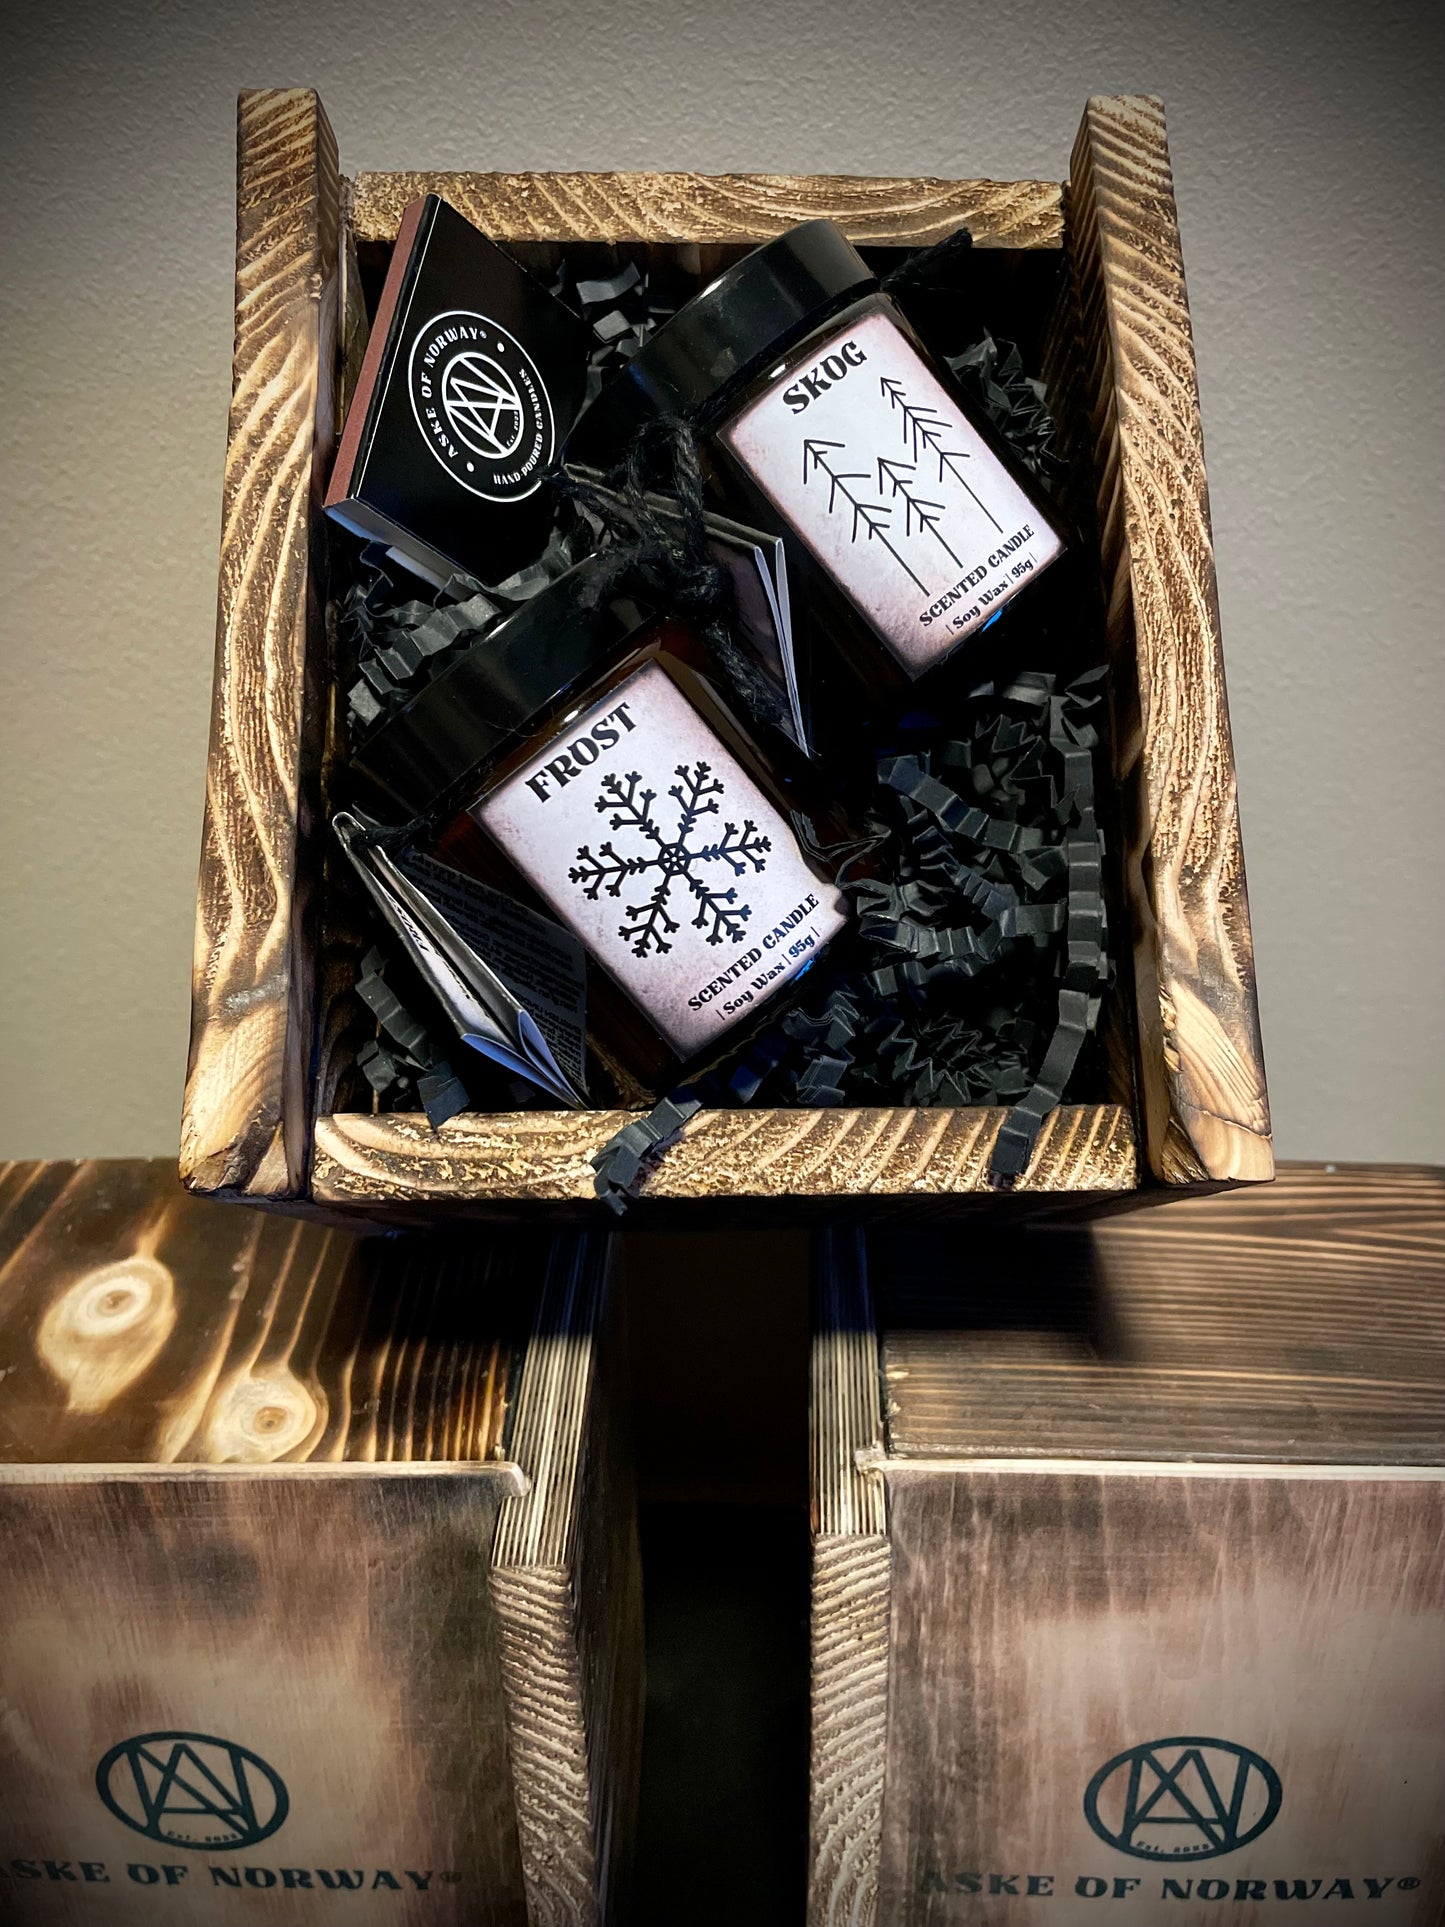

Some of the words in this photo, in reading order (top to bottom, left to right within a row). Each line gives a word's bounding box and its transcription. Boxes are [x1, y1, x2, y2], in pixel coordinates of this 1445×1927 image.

[421, 372, 433, 399] OF
[519, 368, 544, 430] CANDLES
[782, 340, 868, 415] SKOG
[425, 407, 459, 458] ASKE
[919, 565, 988, 627] SCENTED
[988, 524, 1035, 568] CANDLE
[952, 605, 981, 629] Soy
[978, 580, 1009, 606] Wax
[1011, 559, 1034, 578] 95g
[525, 702, 637, 803] FROST
[688, 948, 762, 1011] SCENTED
[762, 893, 819, 950] CANDLE
[723, 990, 754, 1015] Soy
[751, 962, 786, 990] Wax
[127, 1864, 189, 1886] OF
[919, 1871, 1055, 1897] ASKE
[1074, 1876, 1141, 1899] OF
